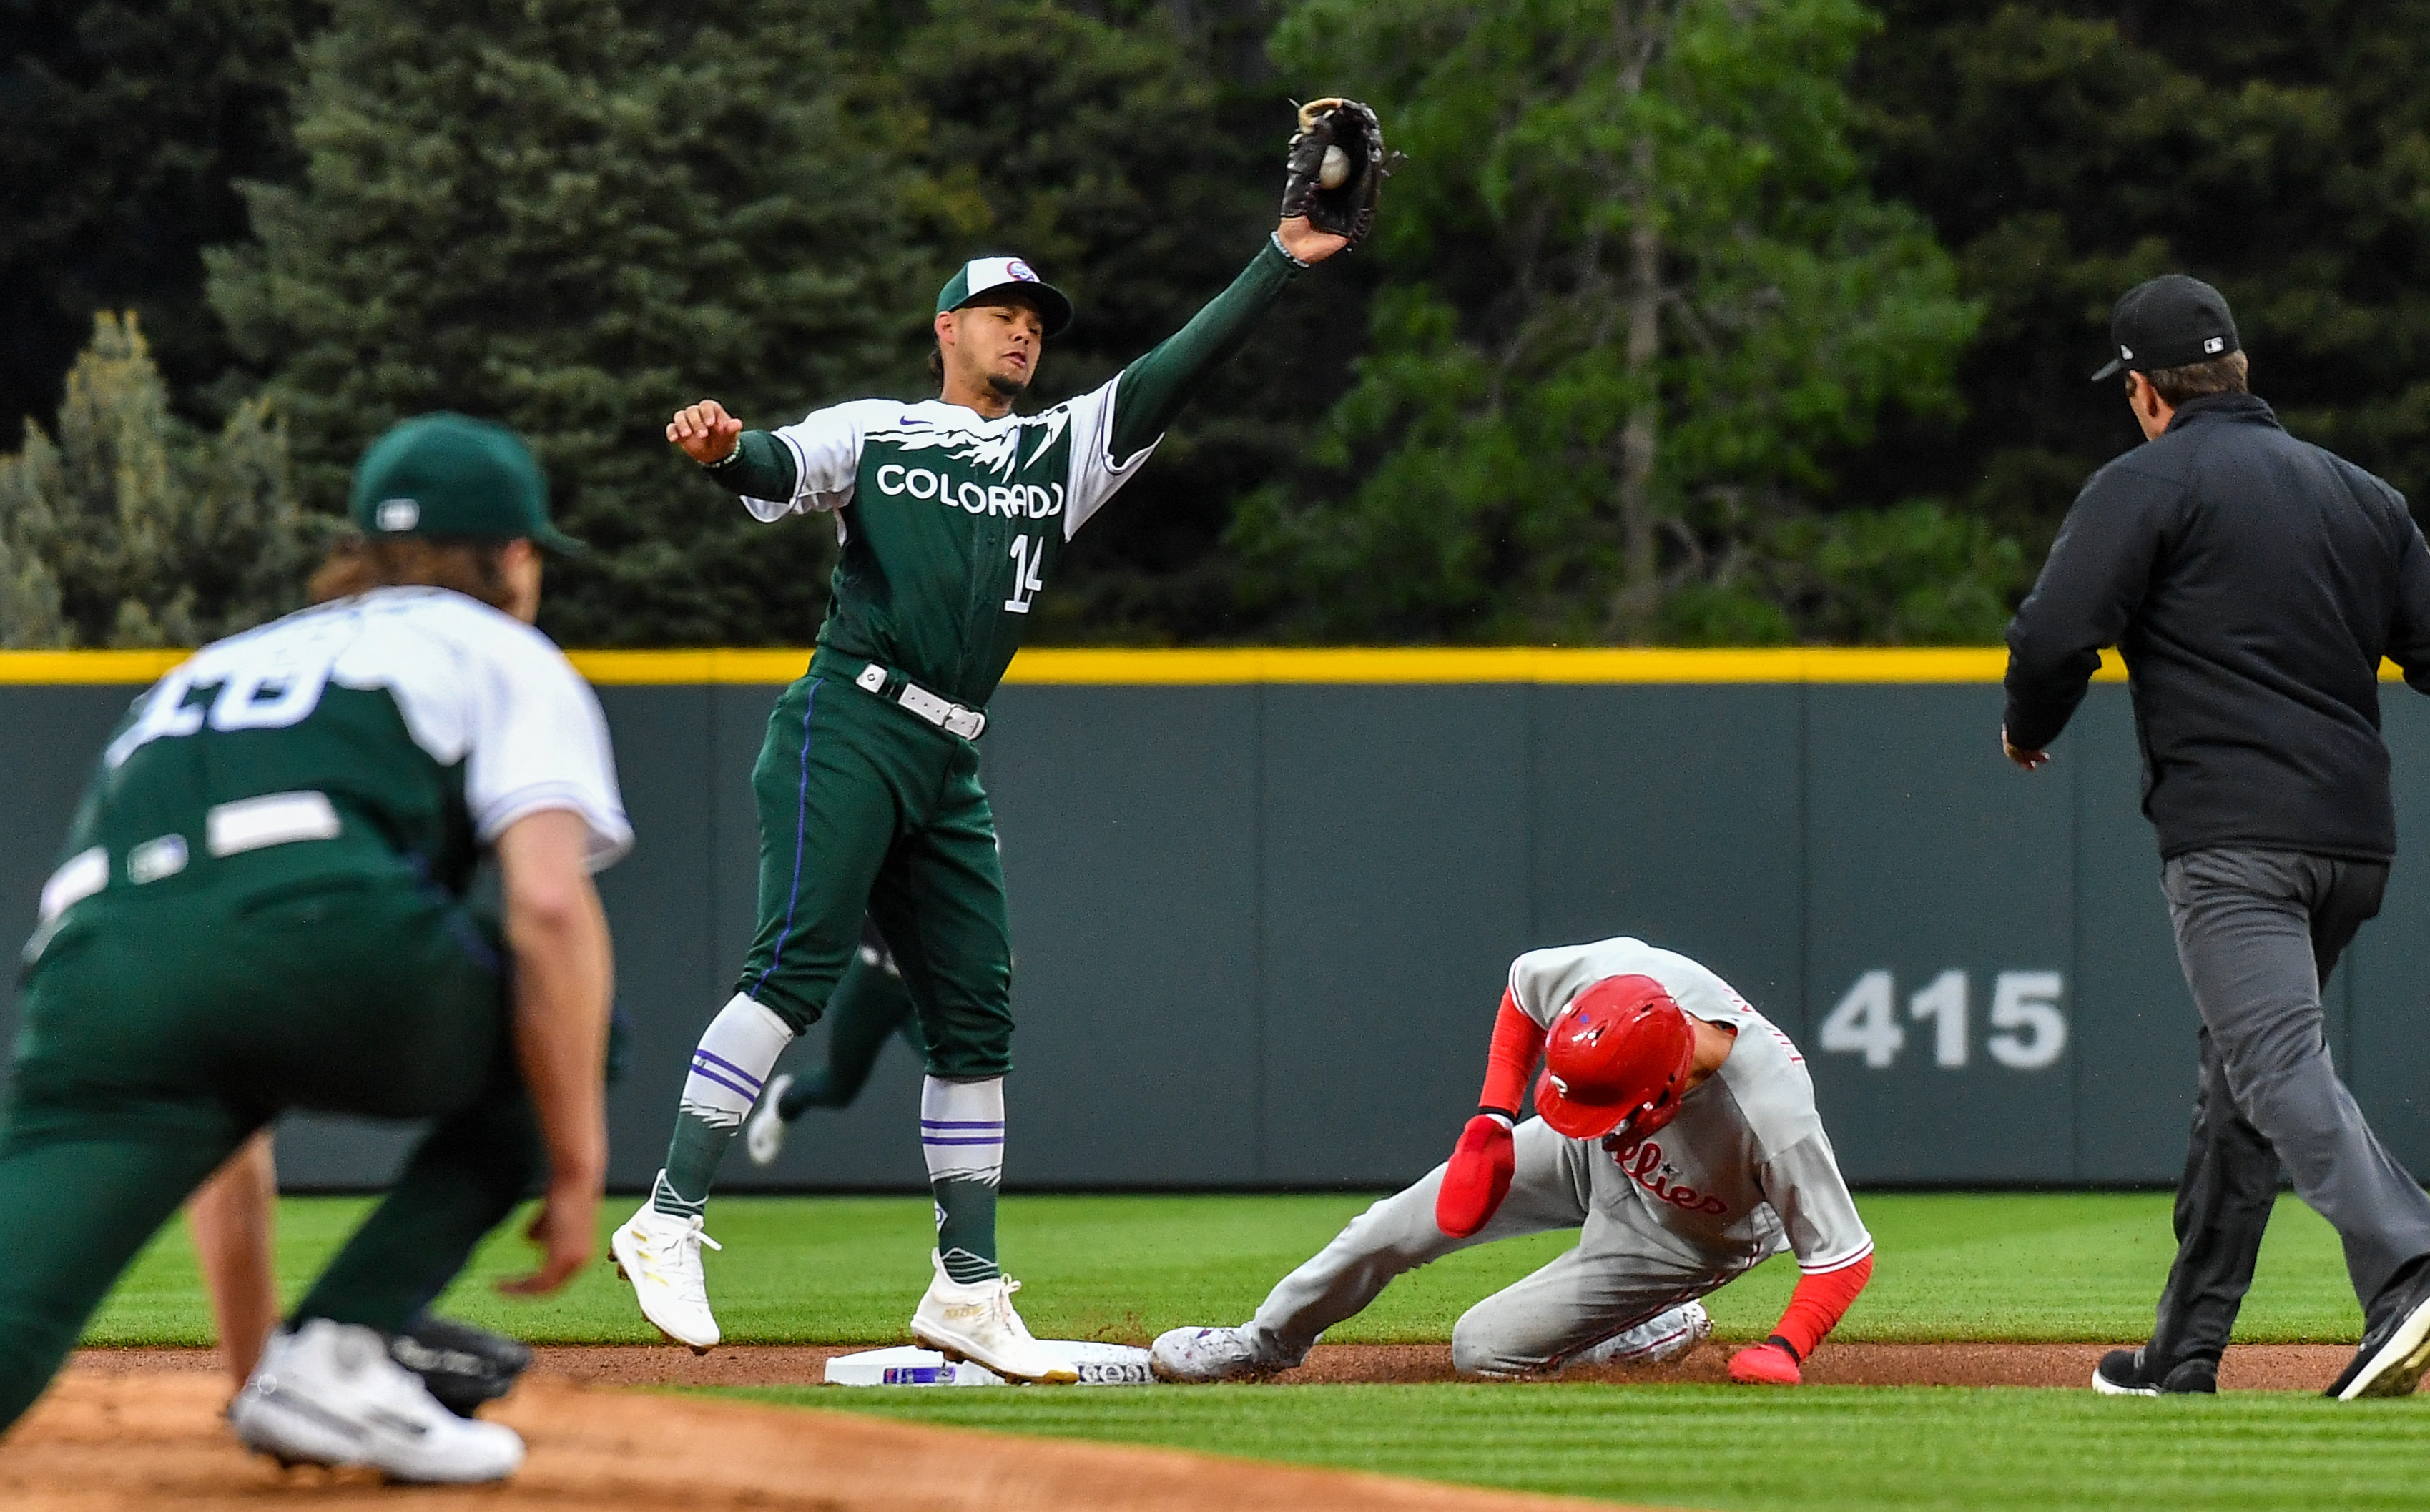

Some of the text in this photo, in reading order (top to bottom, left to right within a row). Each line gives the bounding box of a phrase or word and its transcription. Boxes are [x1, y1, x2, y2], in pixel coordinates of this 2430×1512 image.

[877, 464, 1065, 520] COLORADO
[1004, 533, 1045, 613] 14
[1821, 969, 2067, 1068] 415
